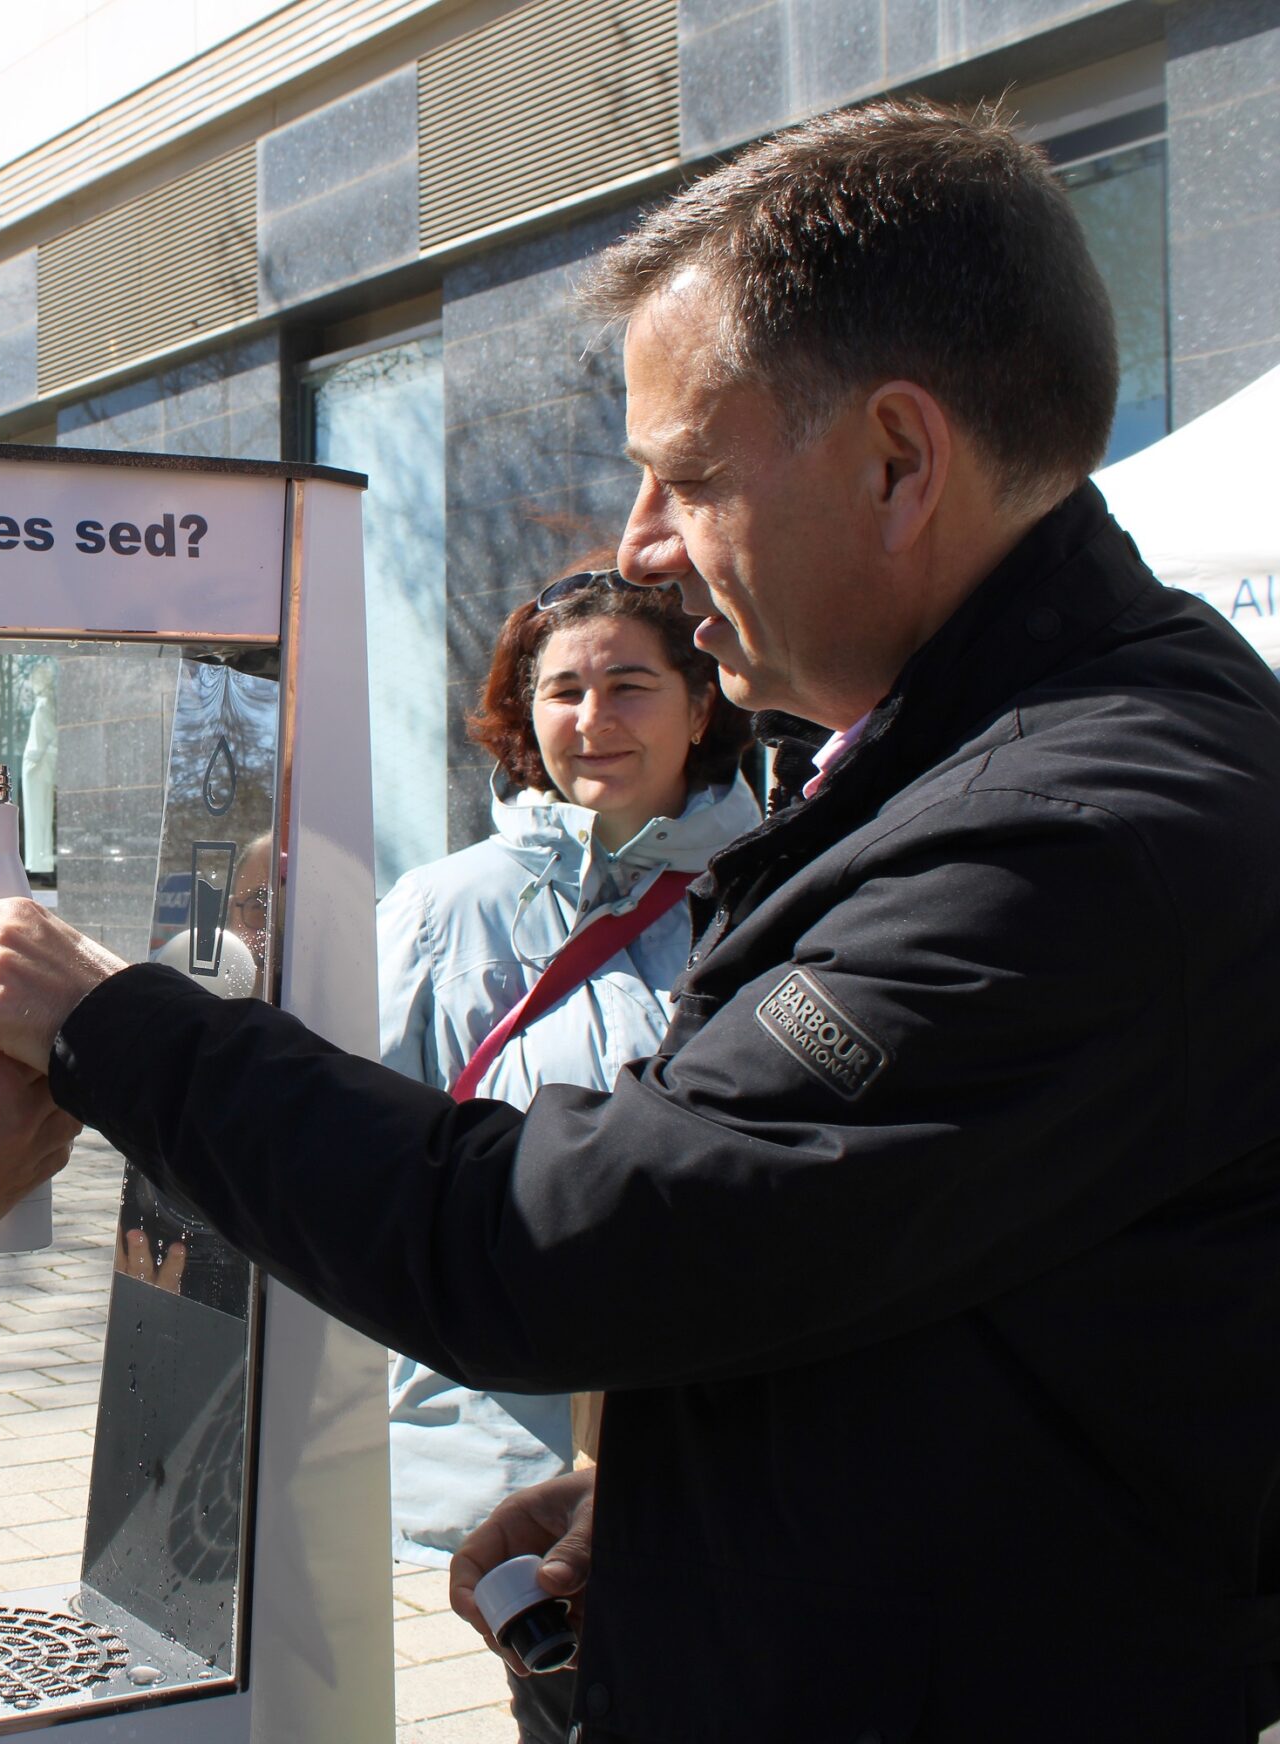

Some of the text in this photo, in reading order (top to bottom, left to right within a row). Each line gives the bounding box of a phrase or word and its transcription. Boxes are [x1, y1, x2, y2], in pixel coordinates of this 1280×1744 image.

[75, 513, 209, 558] sed?
[765, 1000, 857, 1089] INTERNATIONAL
[777, 981, 870, 1074] BARBOUR
